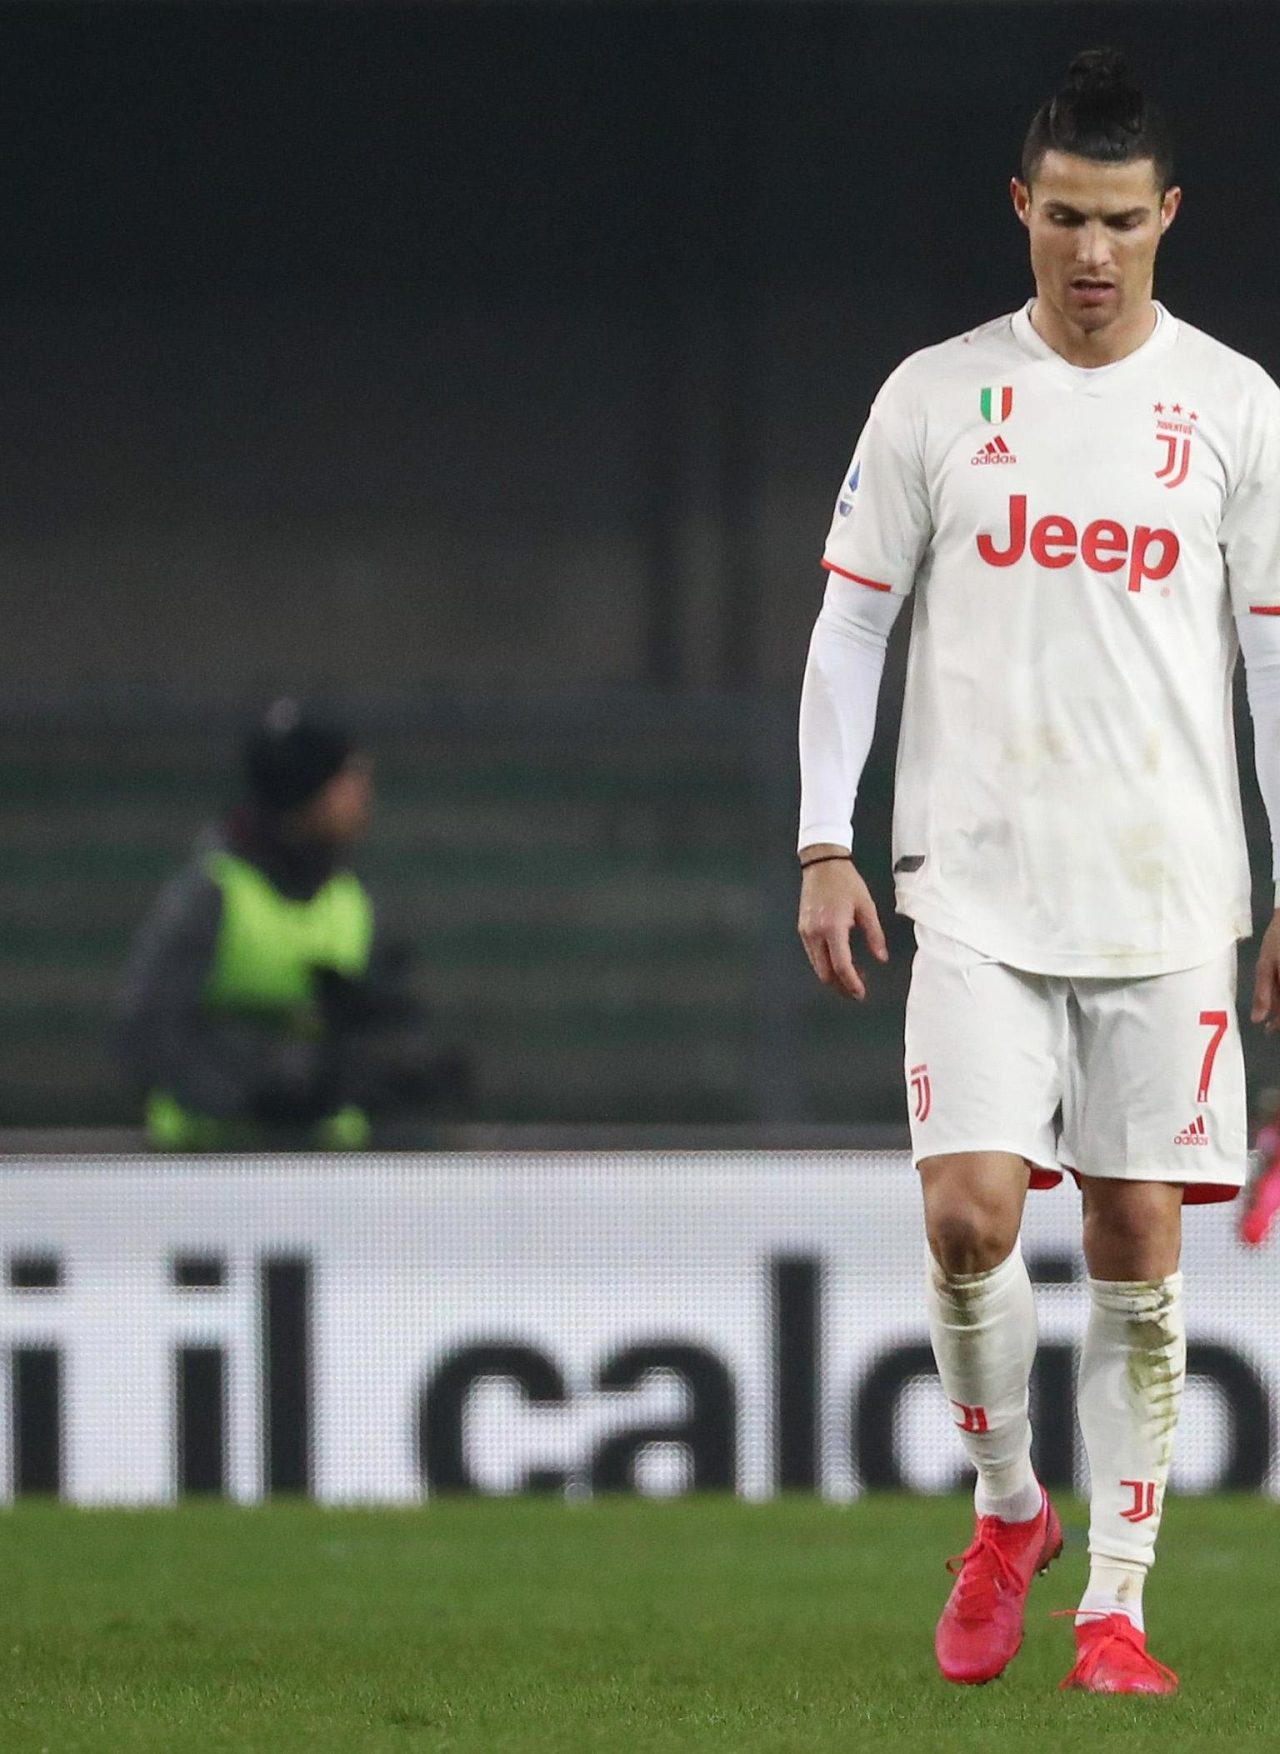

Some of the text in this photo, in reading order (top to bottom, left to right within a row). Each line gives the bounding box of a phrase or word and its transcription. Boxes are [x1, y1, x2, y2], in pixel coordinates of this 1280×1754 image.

[970, 453, 1017, 466] adidas
[976, 494, 1180, 592] Jeep
[1198, 1010, 1228, 1103] 7
[1173, 1134, 1209, 1146] adidas
[174, 1250, 312, 1496] il
